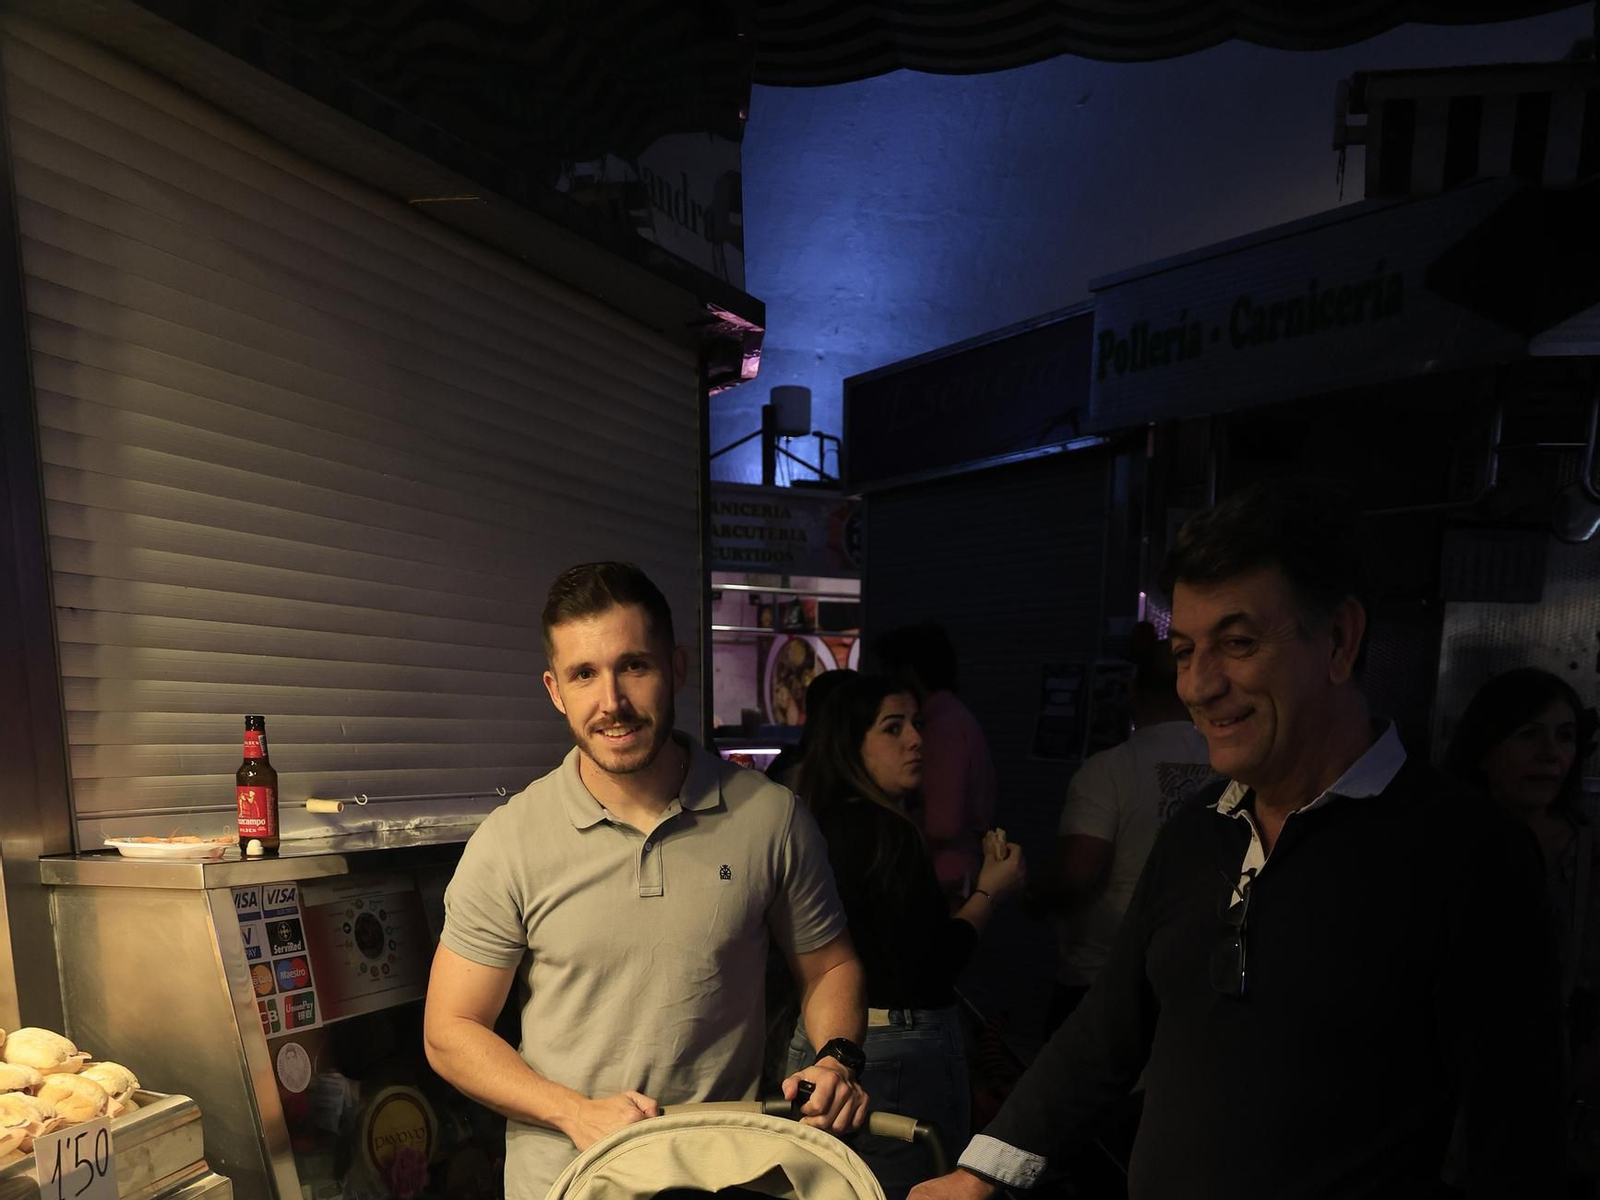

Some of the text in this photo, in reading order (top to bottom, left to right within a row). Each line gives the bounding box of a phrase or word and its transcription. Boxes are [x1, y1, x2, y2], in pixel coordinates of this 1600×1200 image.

[1096, 308, 1203, 381] Pollería
[1229, 258, 1404, 349] Carnicería
[266, 888, 297, 905] VISA
[273, 940, 303, 955] ServiRed
